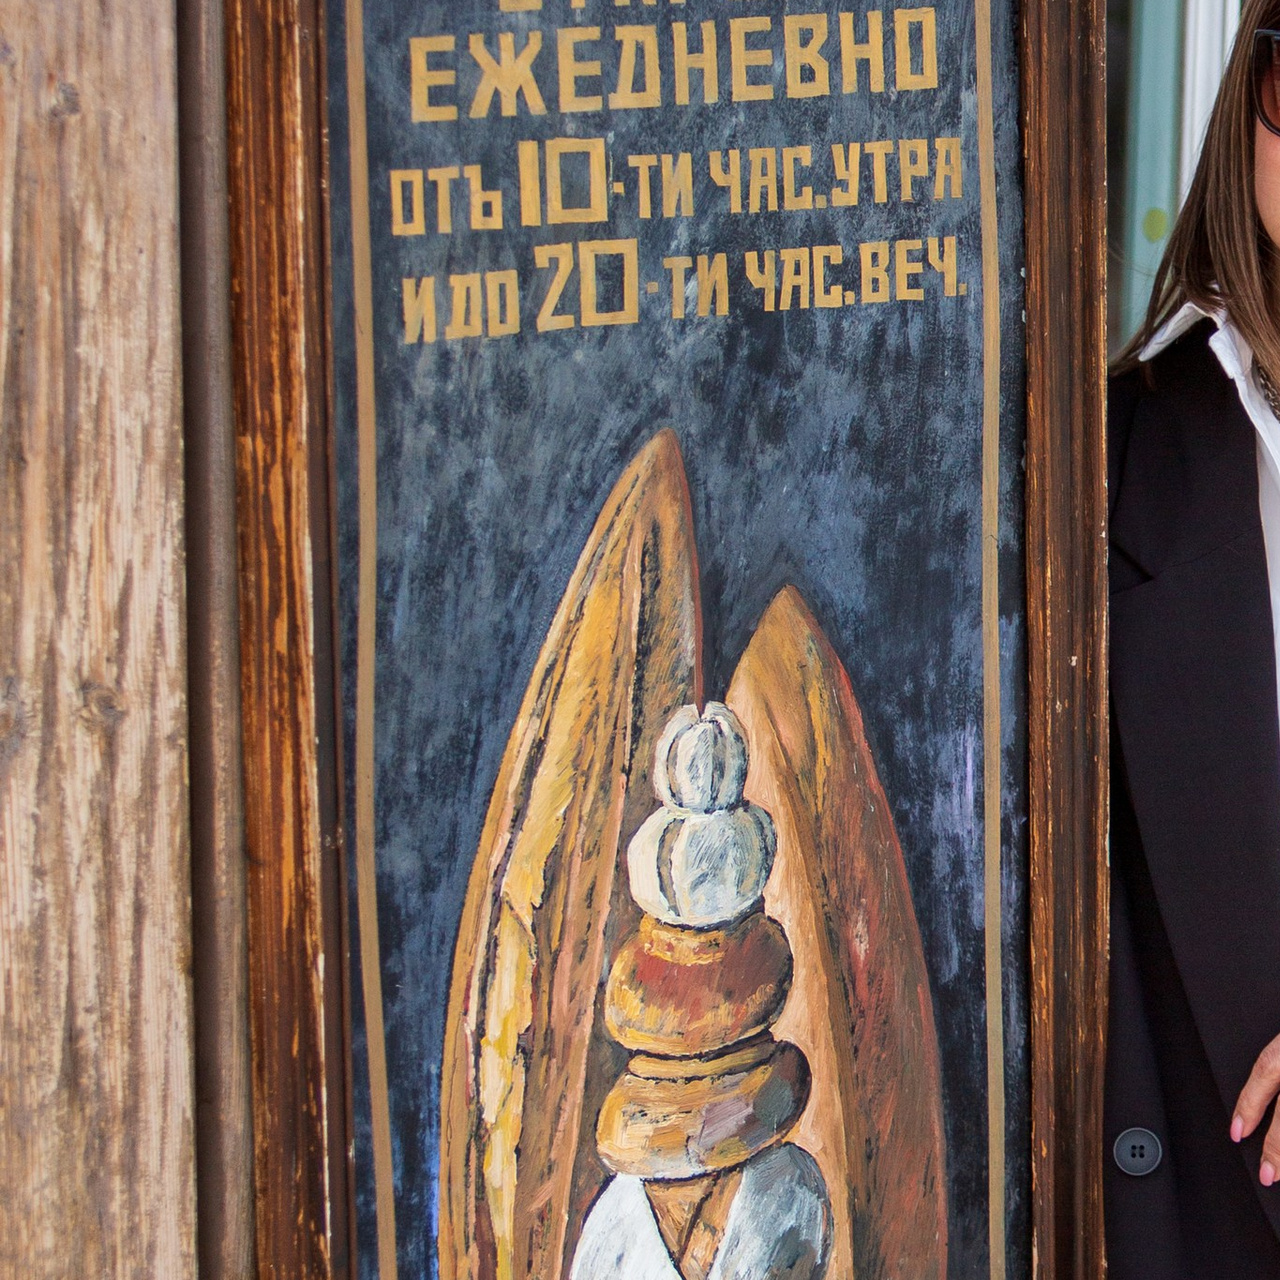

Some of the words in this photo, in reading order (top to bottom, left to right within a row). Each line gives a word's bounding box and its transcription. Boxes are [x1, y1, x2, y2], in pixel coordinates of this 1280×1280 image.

[409, 7, 938, 122] ЕЖЕДНЕВНО
[390, 165, 503, 236] ОТЪ
[402, 276, 436, 344] И
[445, 269, 520, 341] ДО
